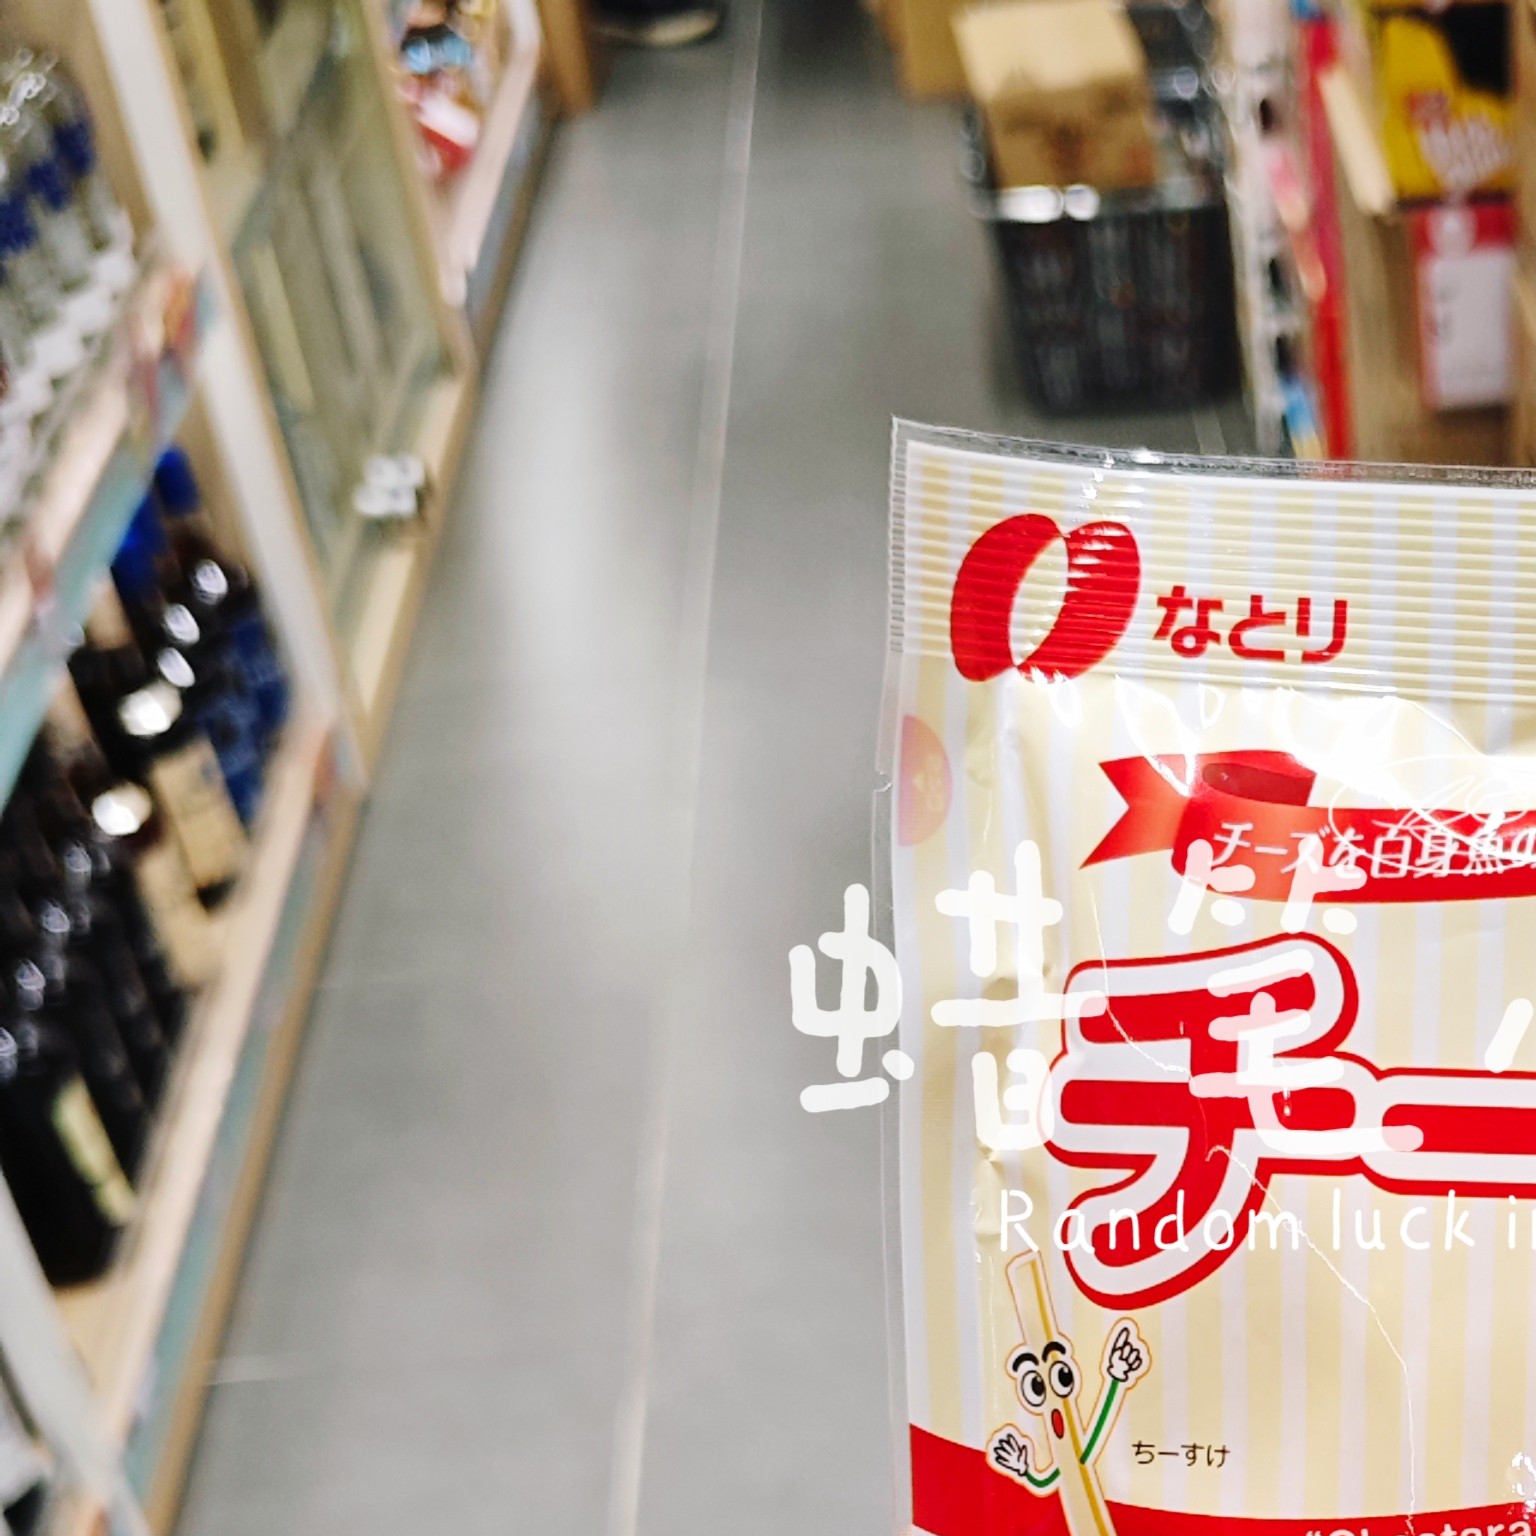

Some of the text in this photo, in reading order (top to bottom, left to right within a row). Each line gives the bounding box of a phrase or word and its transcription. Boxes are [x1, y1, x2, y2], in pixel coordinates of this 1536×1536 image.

[1152, 585, 1349, 664] なとり
[1132, 1440, 1231, 1468] ちーすけ
